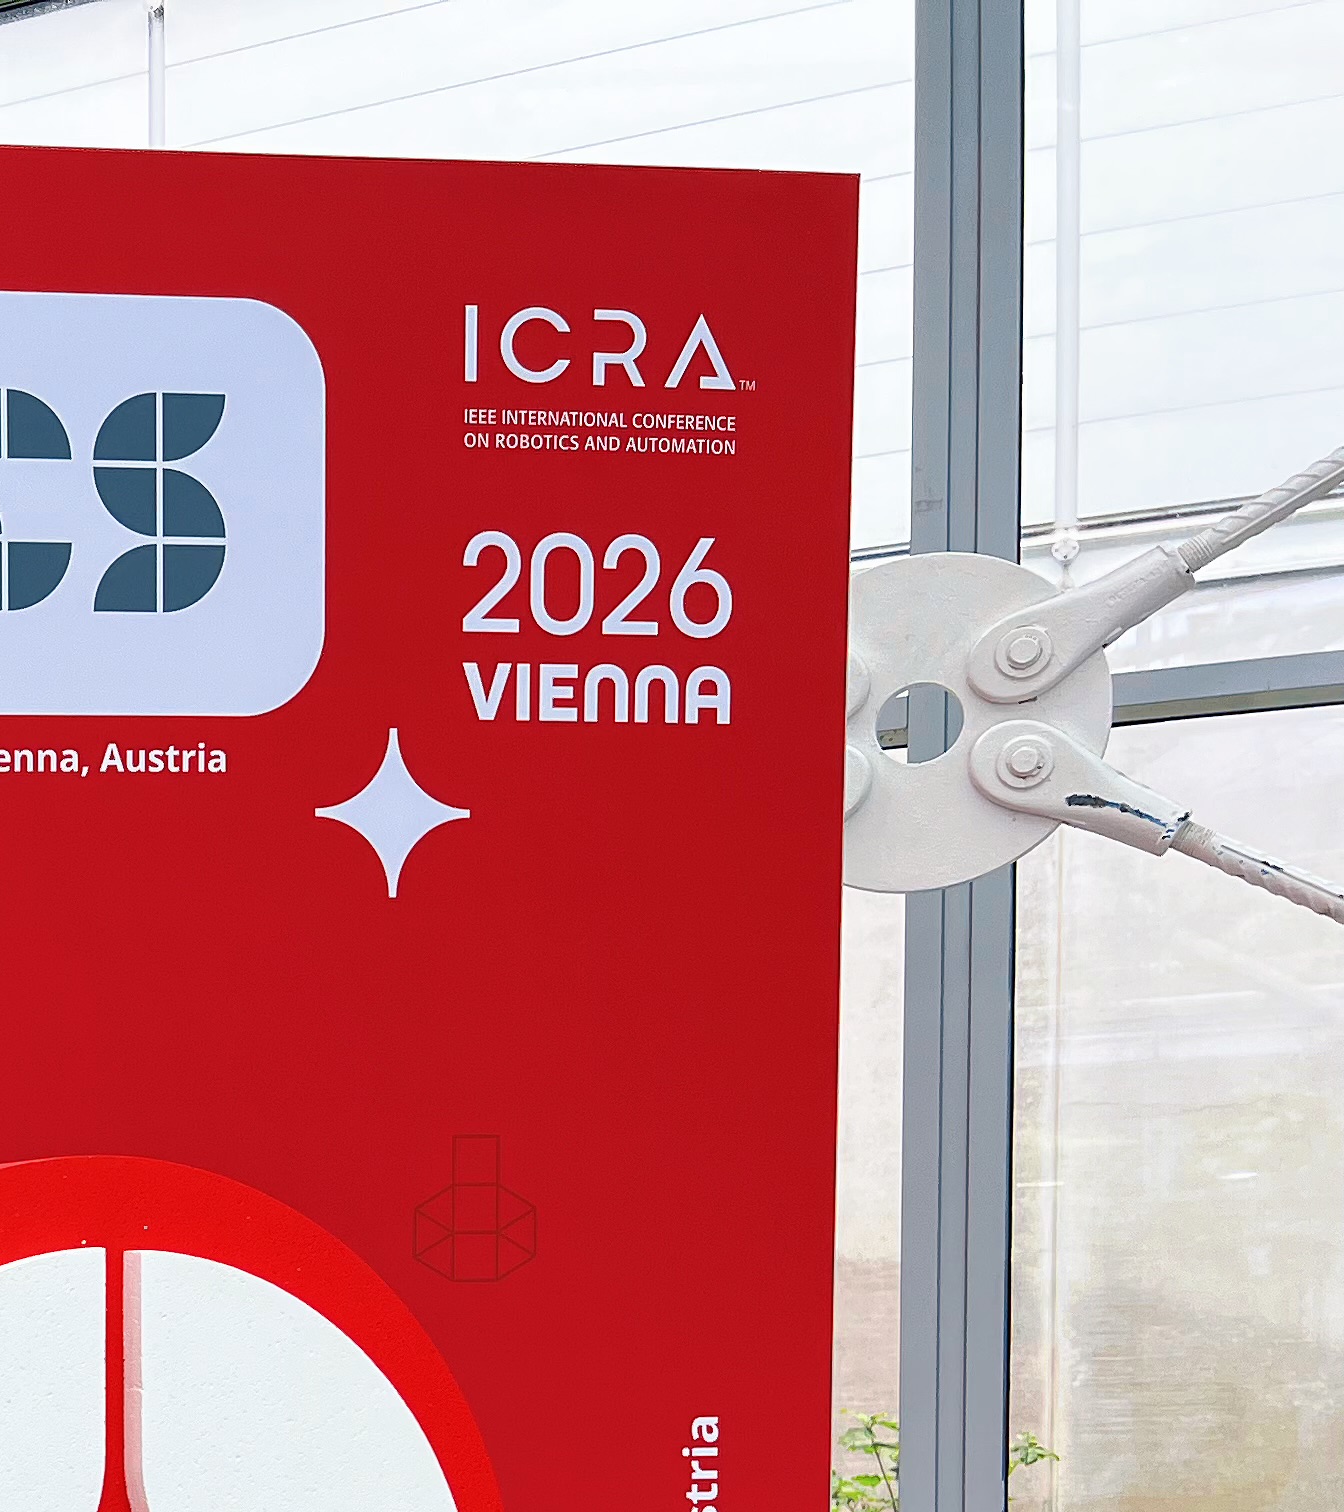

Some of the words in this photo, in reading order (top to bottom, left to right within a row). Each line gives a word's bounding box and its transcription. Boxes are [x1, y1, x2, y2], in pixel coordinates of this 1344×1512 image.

[464, 304, 737, 391] ICRA
[463, 408, 497, 426] IEEE
[501, 409, 628, 429] INTERNATIONAL
[632, 413, 736, 432] CONFERENCE
[463, 432, 490, 449] ON
[495, 433, 580, 452] ROBOTICS
[584, 435, 621, 452] AND
[625, 437, 736, 455] AUTOMATION
[462, 530, 733, 639] 2026
[99, 742, 227, 773] Austria
